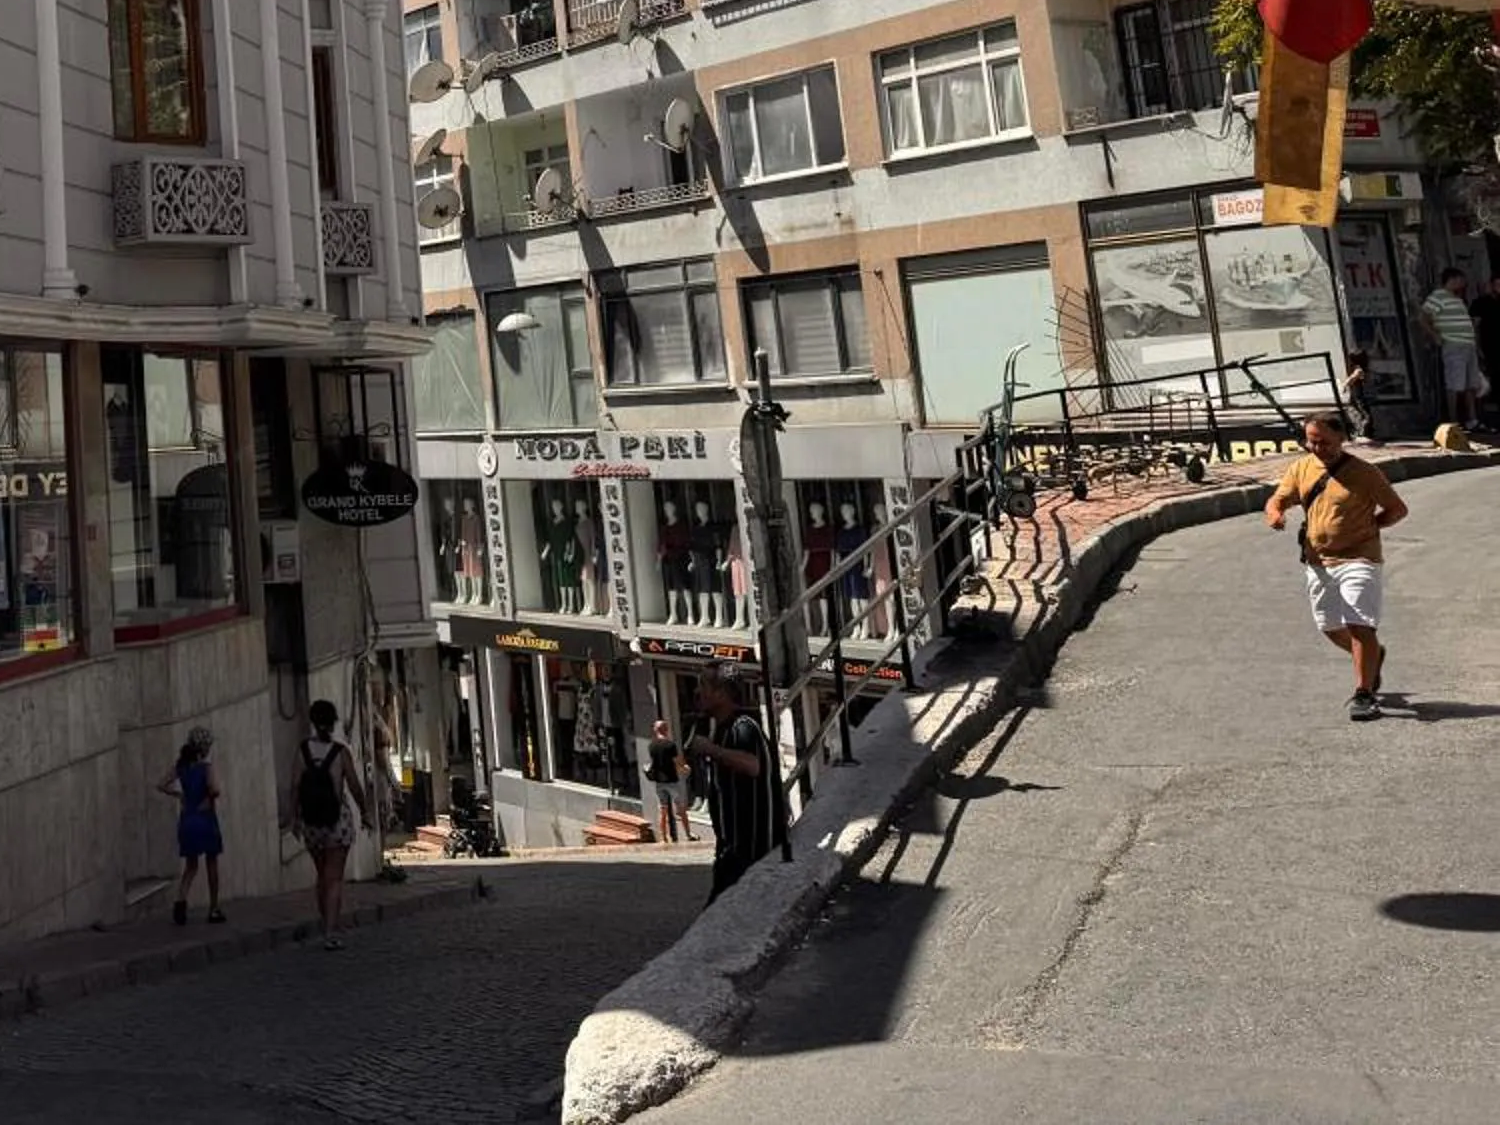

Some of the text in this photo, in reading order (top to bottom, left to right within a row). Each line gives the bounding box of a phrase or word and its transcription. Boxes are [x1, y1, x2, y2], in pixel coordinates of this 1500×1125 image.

[516, 437, 605, 460] MODA
[307, 493, 414, 509] GRAND KYBELE
[338, 508, 385, 521] HOTEL
